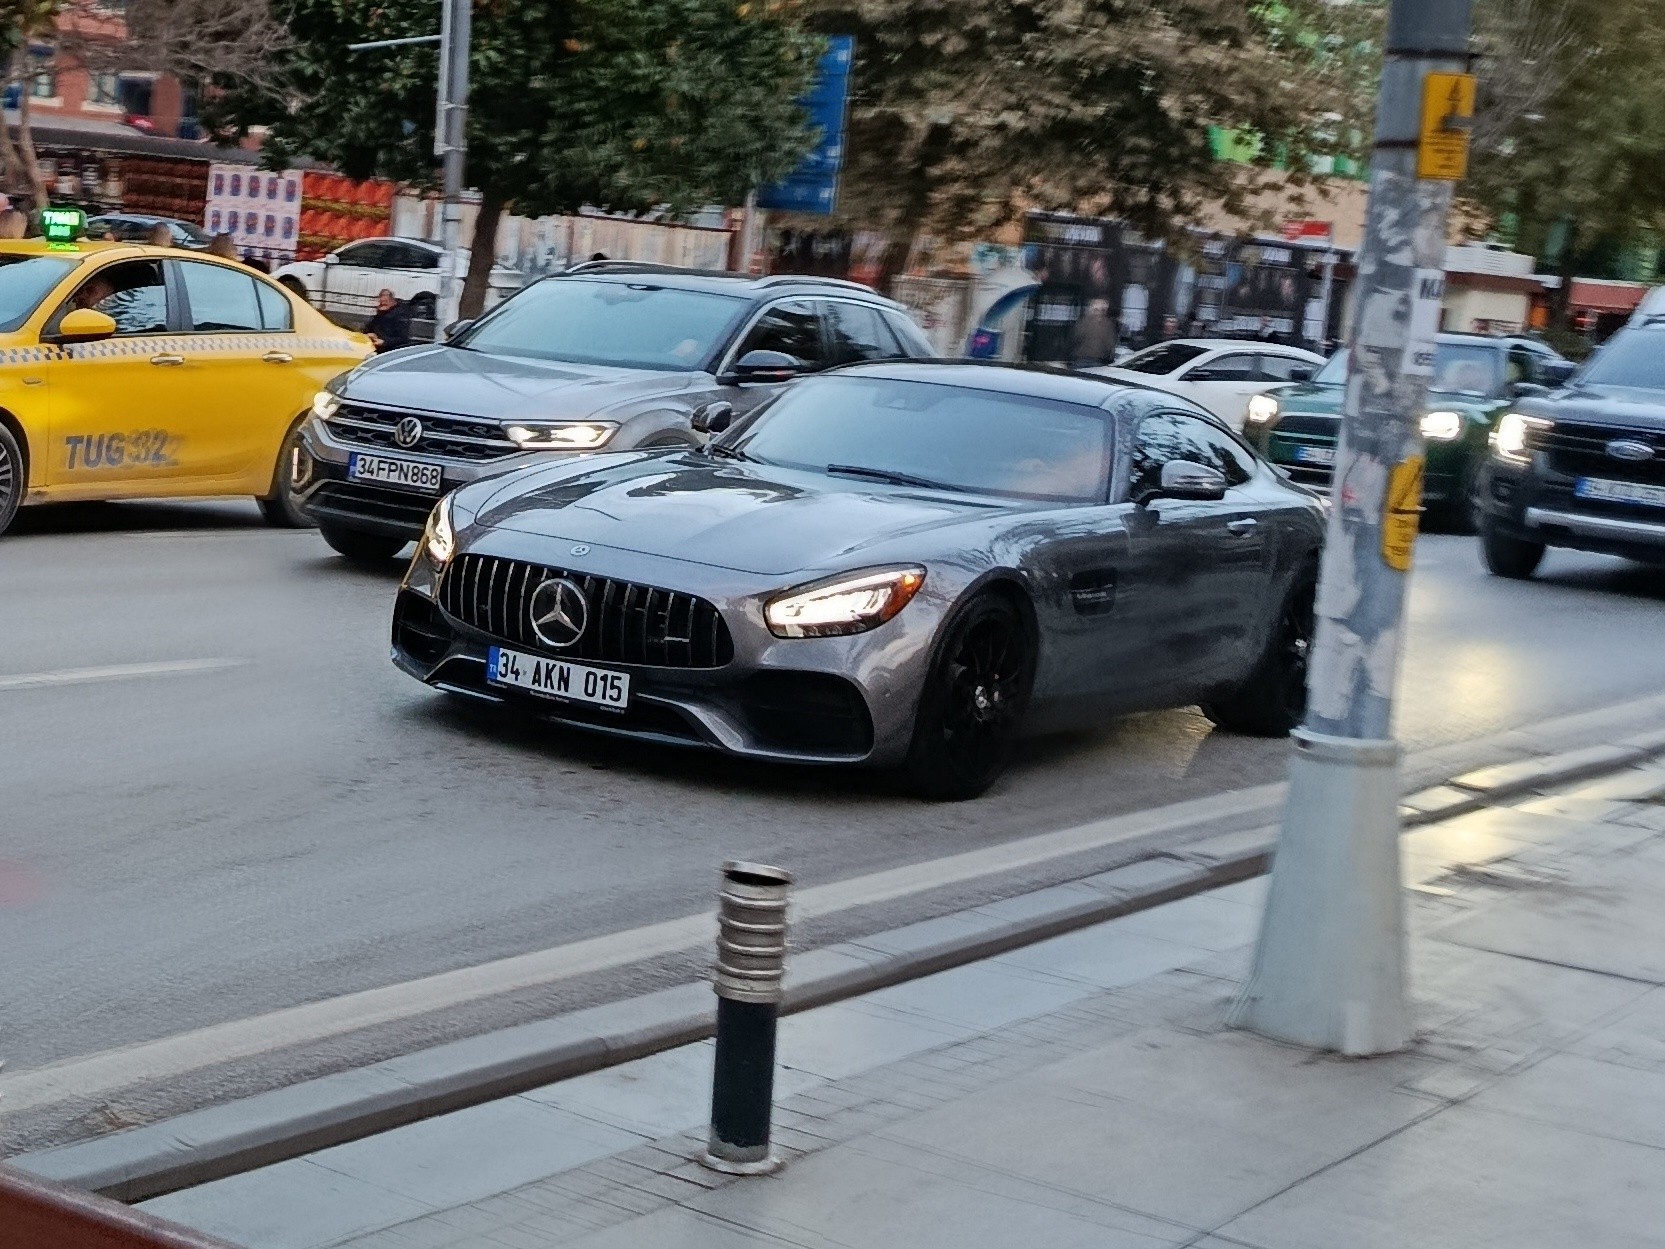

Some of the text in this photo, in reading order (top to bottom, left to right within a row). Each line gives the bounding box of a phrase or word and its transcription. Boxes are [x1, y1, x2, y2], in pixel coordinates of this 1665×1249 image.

[65, 431, 125, 469] TUG
[357, 457, 440, 486] 34FPN868
[498, 652, 521, 681] 34
[531, 660, 571, 693] AKN
[583, 670, 623, 702] 015
